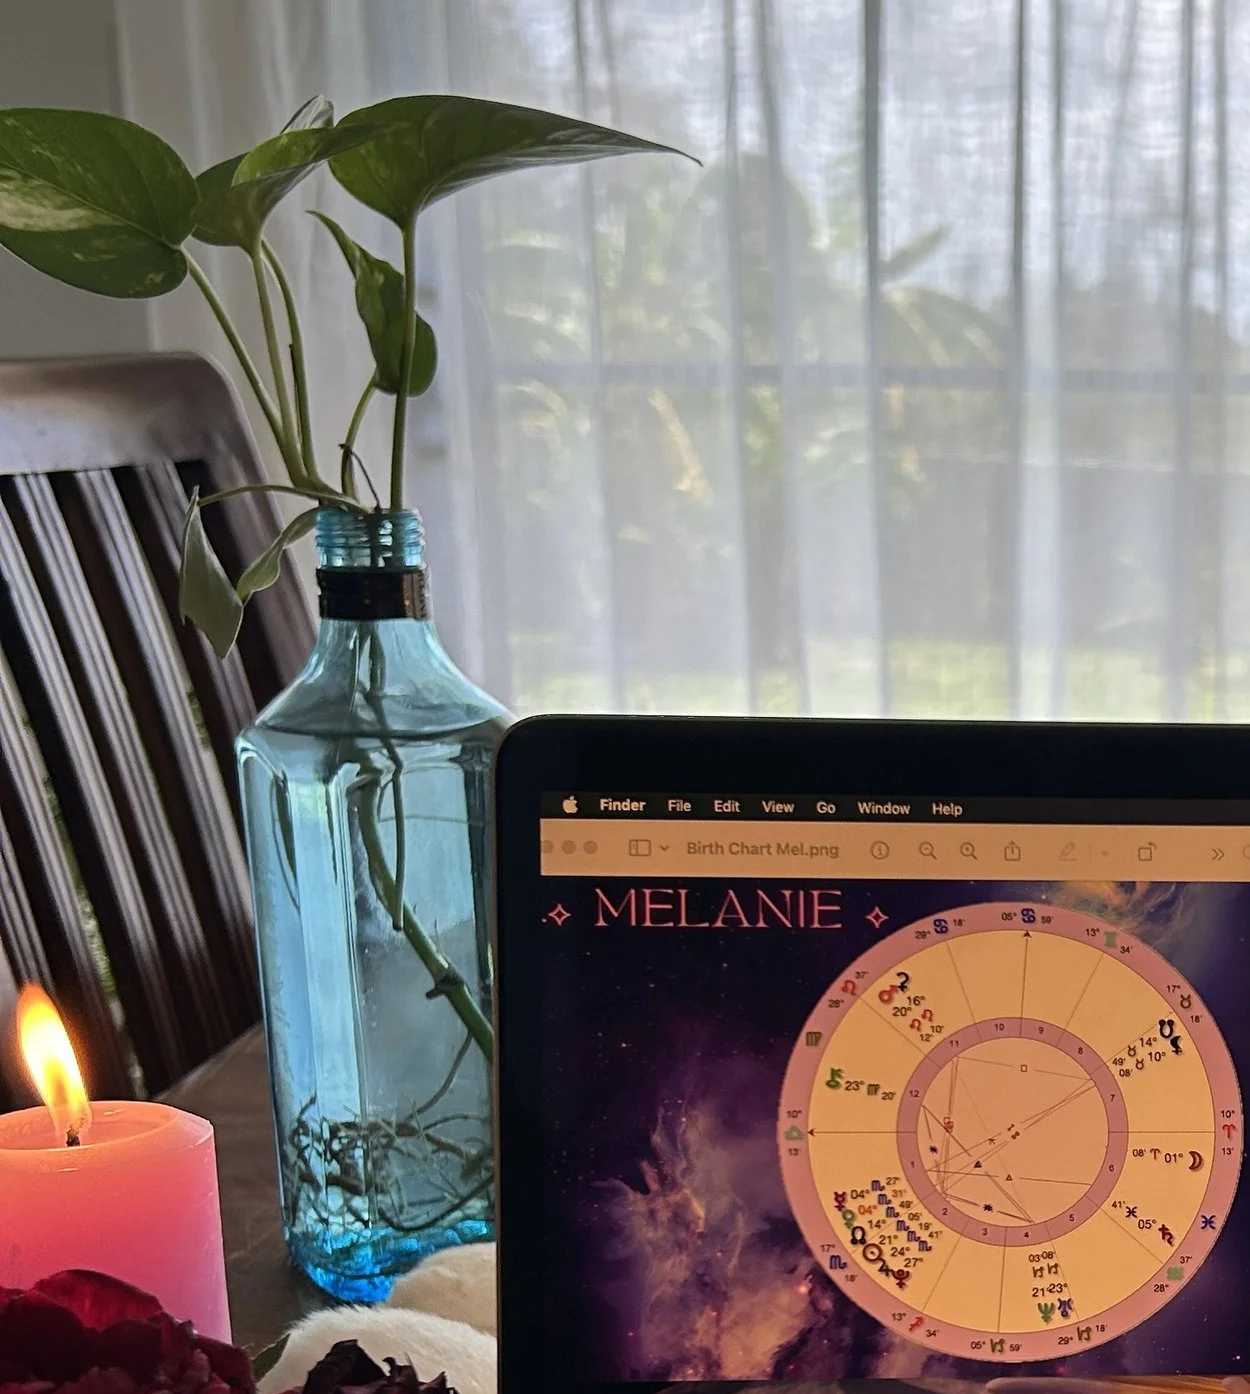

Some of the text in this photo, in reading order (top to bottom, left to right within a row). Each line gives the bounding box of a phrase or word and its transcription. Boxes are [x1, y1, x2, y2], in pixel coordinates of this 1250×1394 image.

[600, 798, 963, 818] Finder File Edit View Go Window Help
[686, 842, 839, 860] Birth Chart Mel.png
[594, 888, 843, 928] MELANIE
[994, 1023, 1005, 1031] 10
[1038, 1026, 1044, 1034] 9
[950, 1040, 959, 1048] 11
[909, 1090, 919, 1098] 12
[1109, 1164, 1115, 1172] 6
[1069, 1214, 1075, 1222] 5
[982, 1228, 988, 1236] 3
[1024, 1231, 1029, 1239] 4
